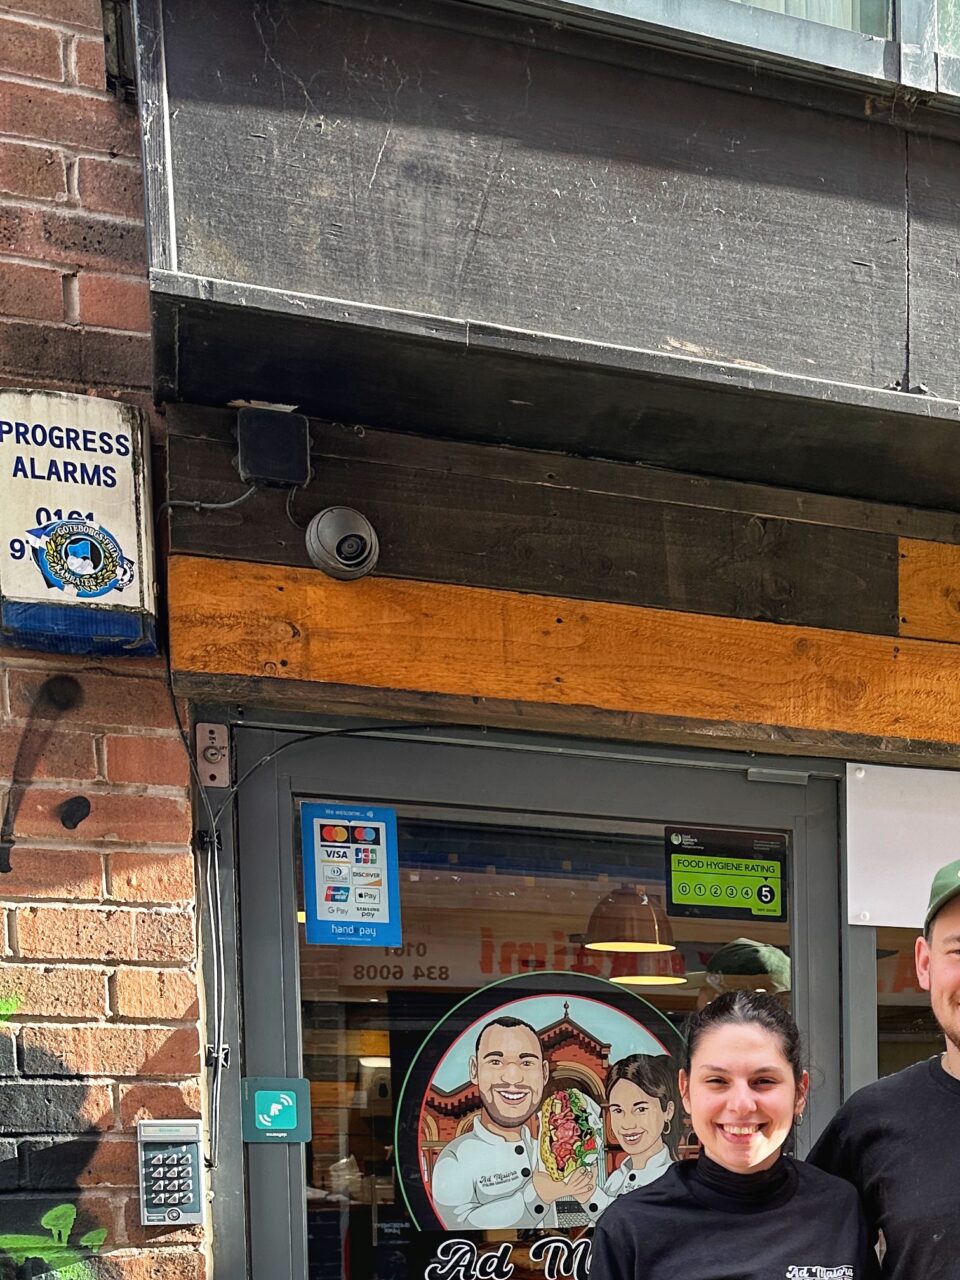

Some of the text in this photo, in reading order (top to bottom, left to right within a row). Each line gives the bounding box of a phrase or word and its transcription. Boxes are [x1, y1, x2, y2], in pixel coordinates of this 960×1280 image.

[0, 420, 131, 457] PROGRESS
[12, 456, 117, 488] ALARMS
[325, 850, 348, 859] VISA
[677, 859, 775, 874] FOOD HYGIENE RATING
[363, 892, 377, 900] Pay
[761, 887, 771, 902] 5
[336, 906, 349, 915] Pay
[785, 1265, 854, 1279] Ad Maiora
